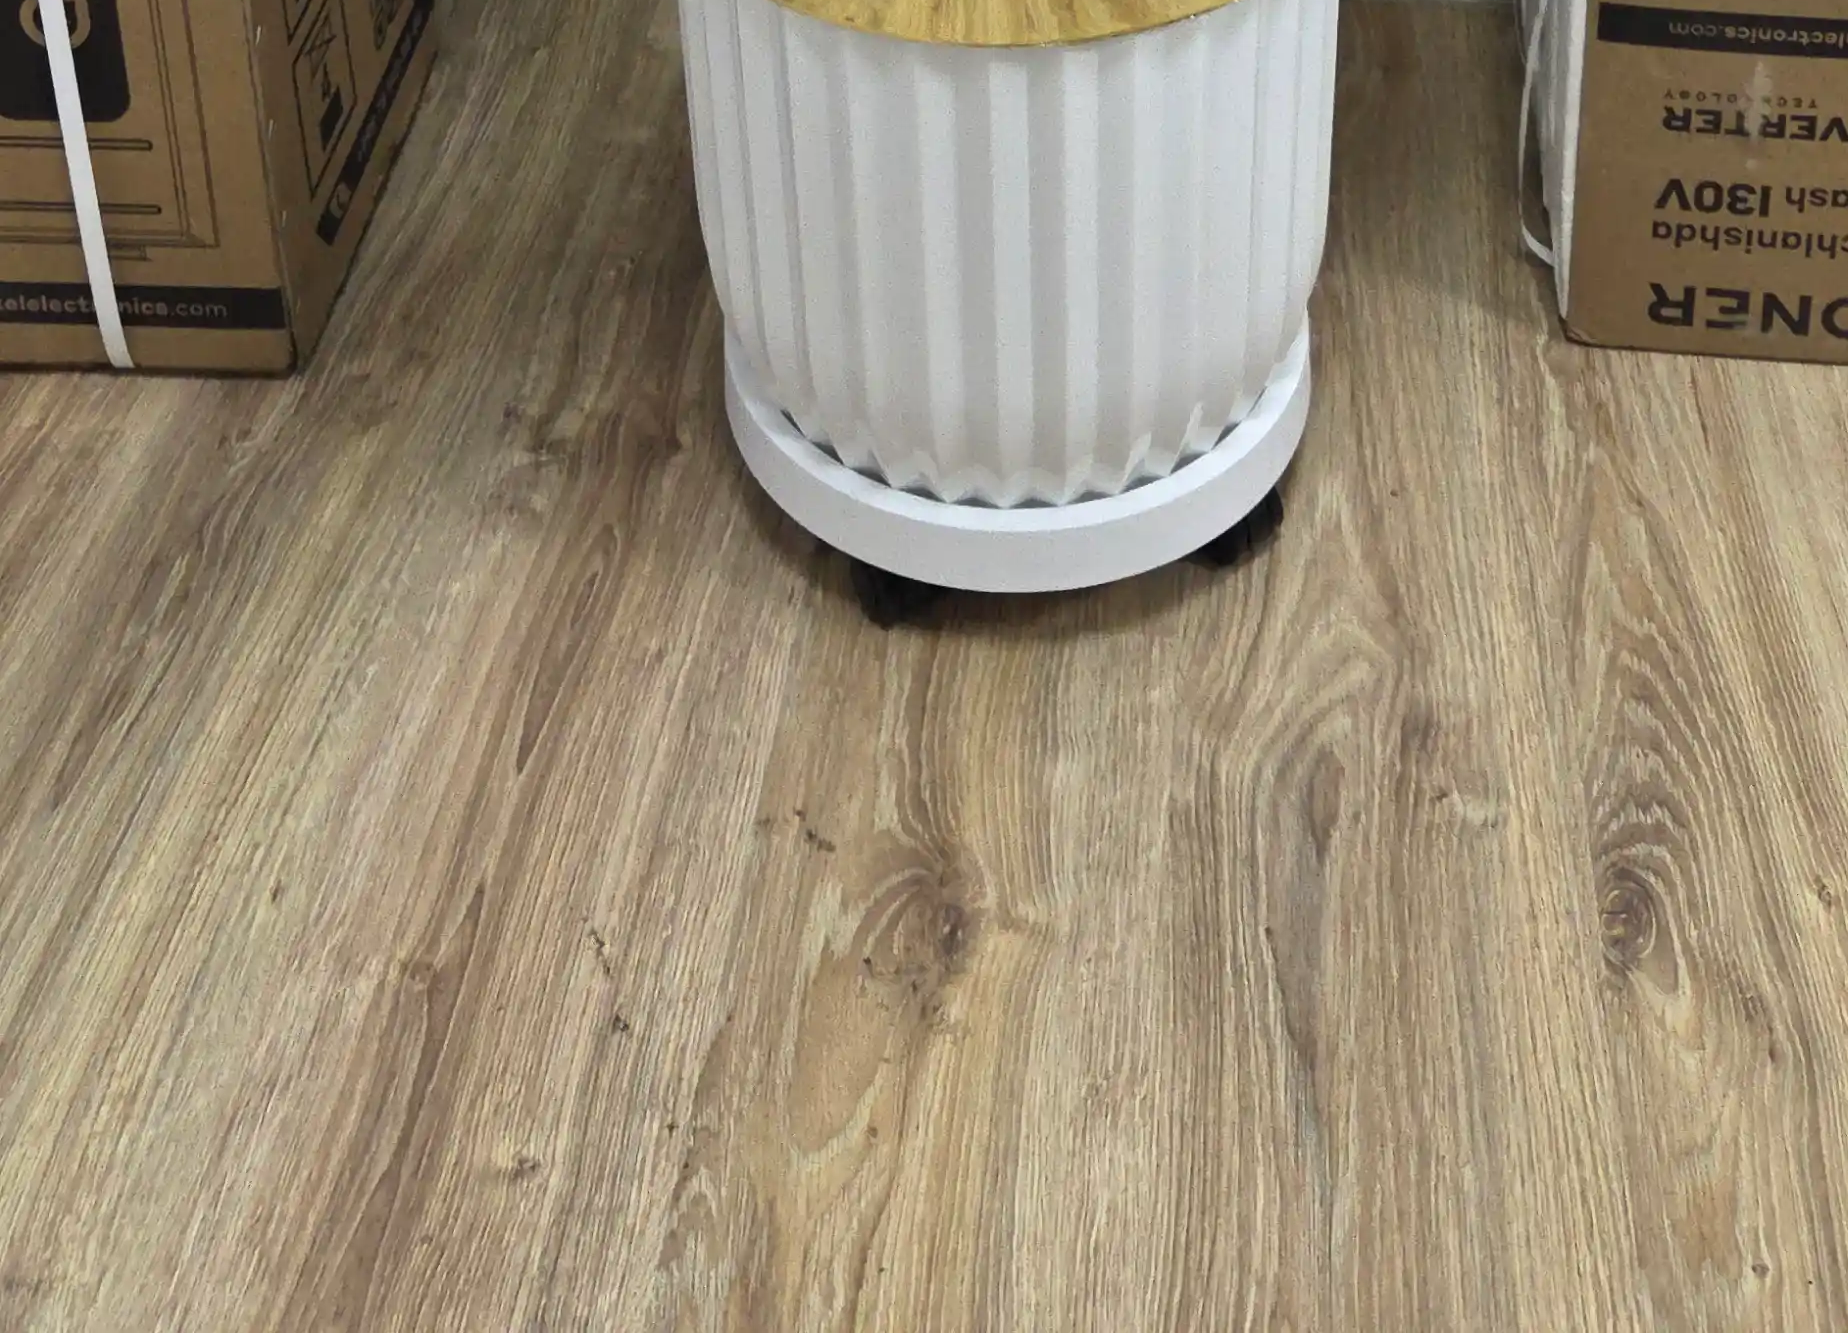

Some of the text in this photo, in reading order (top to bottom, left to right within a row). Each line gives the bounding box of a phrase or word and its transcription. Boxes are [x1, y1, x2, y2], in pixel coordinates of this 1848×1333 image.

[1668, 21, 1848, 50] lectronics.com
[1663, 88, 1819, 110] TECHOLOGY
[0, 294, 229, 319] elelectnics.com
